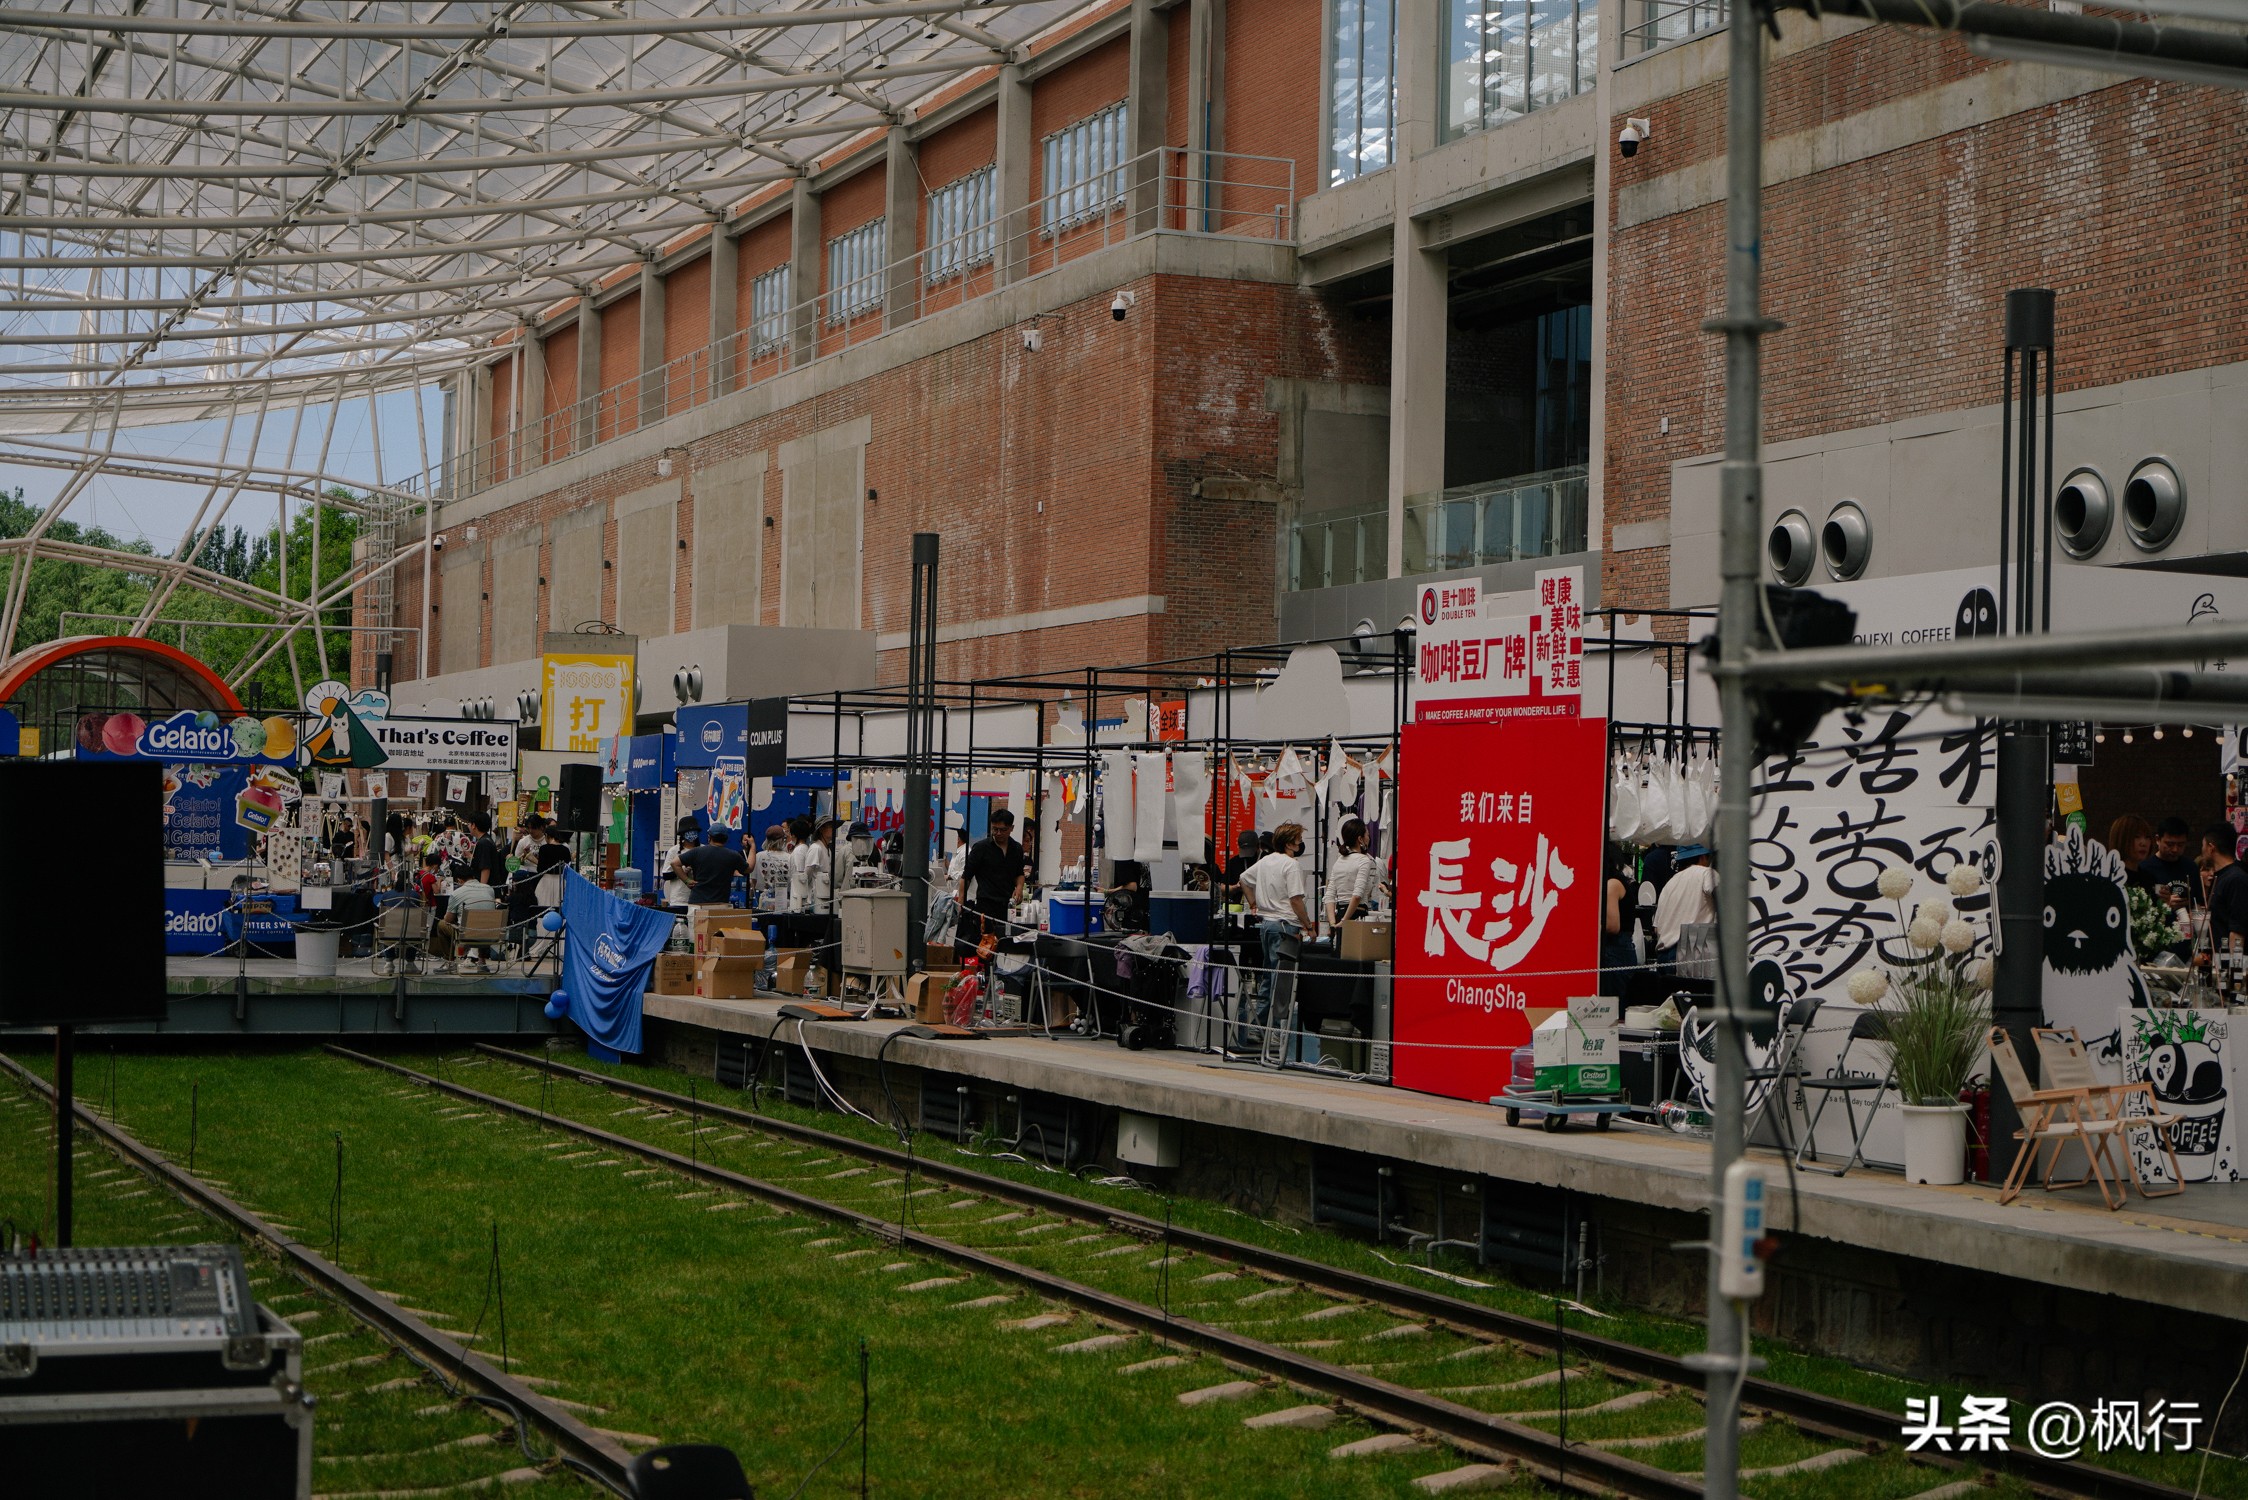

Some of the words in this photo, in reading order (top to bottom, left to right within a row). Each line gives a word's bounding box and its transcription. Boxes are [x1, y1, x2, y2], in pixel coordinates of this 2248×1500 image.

[1541, 576, 1572, 606] 健康
[1441, 611, 1464, 621] DOUBLE
[1465, 609, 1476, 618] TEN
[1550, 603, 1580, 633] 美味
[1901, 627, 1952, 644] COFFEE
[1536, 632, 1567, 662] 新鲜
[1420, 634, 1526, 684] 咖啡豆厂牌
[1551, 660, 1581, 689] 实惠
[1425, 709, 1441, 720] MAKE
[1441, 708, 1464, 719] COFFEE
[1464, 708, 1469, 718] A
[1469, 708, 1484, 718] PART
[1484, 707, 1494, 717] OF
[1495, 706, 1512, 717] YOUR
[1512, 705, 1551, 717] WONDERFUL
[1552, 704, 1566, 714] LIFE
[148, 724, 229, 755] Gelato!
[377, 728, 439, 745] That's
[443, 729, 509, 747] Coffee
[750, 730, 767, 746] COLIN
[767, 729, 782, 745] PLUS
[388, 749, 424, 757] 咖啡店地址
[171, 796, 222, 812] Gelato!
[1460, 791, 1533, 824] 我们来自
[170, 812, 221, 828] Gelato!
[865, 806, 934, 832] BEAS
[170, 829, 221, 845] Gelato!
[1446, 978, 1526, 1013] ChangSha
